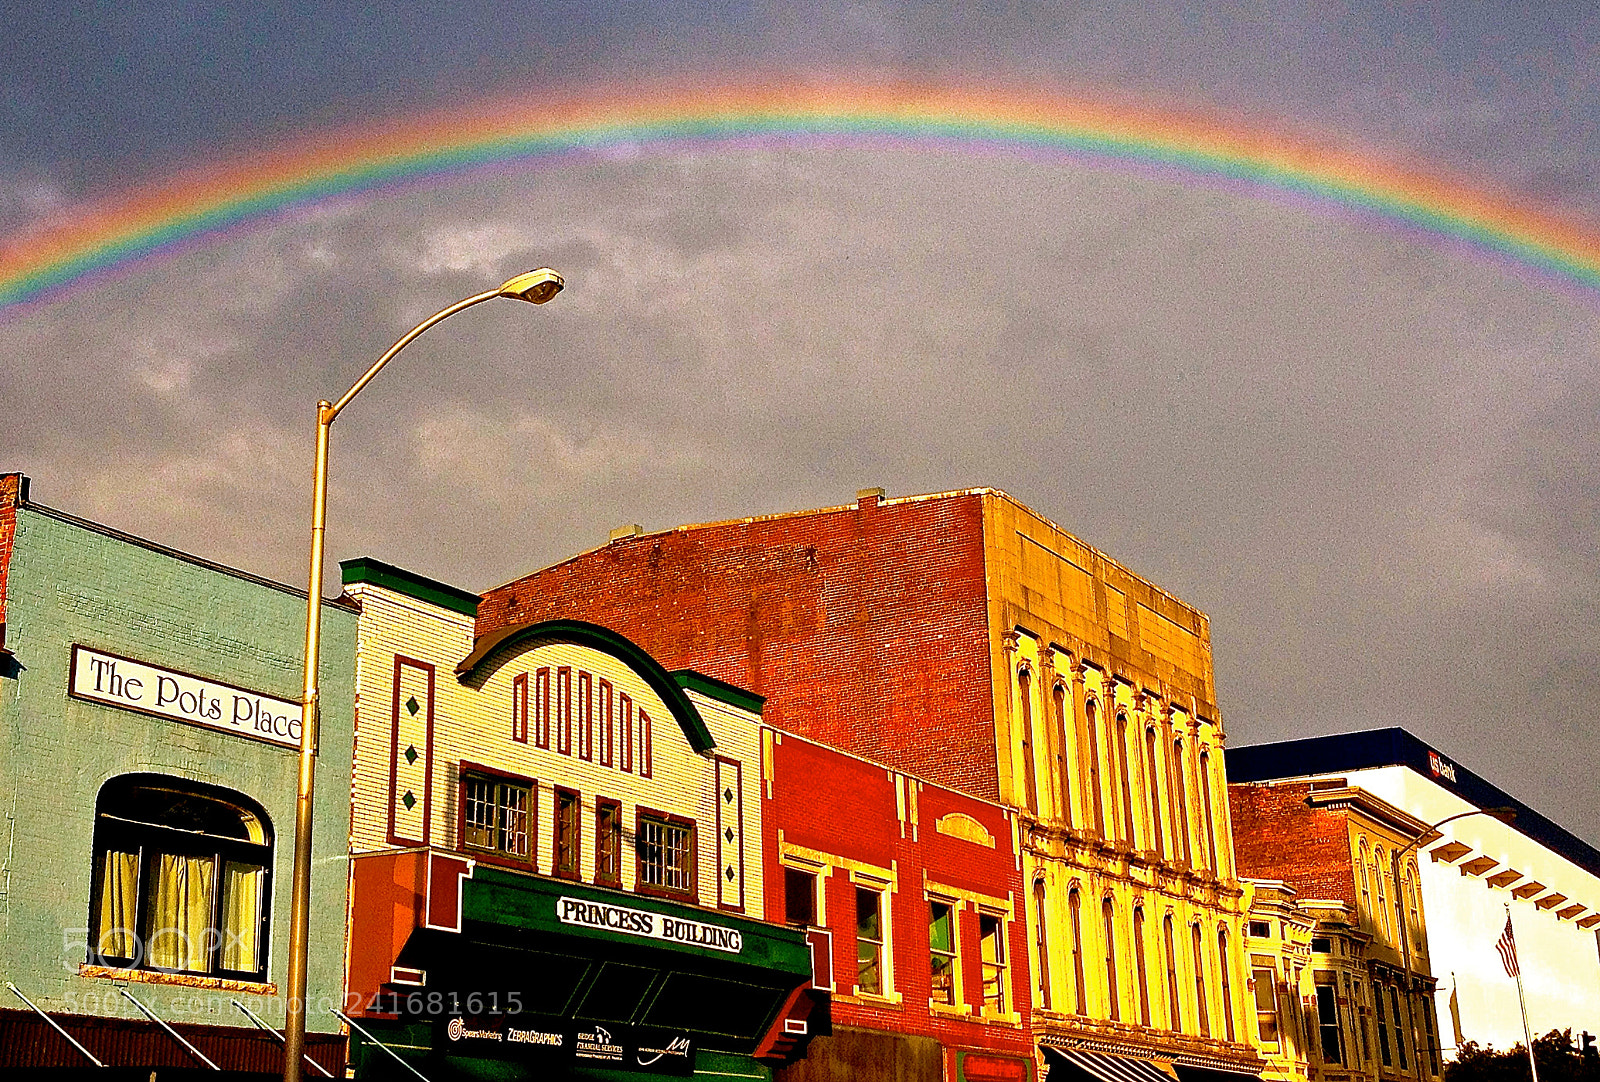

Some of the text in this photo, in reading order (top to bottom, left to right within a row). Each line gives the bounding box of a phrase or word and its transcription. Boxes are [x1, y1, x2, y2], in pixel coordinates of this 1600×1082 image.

[90, 656, 303, 740] The Pots Place
[562, 903, 741, 950] PRINCESS BUILDING
